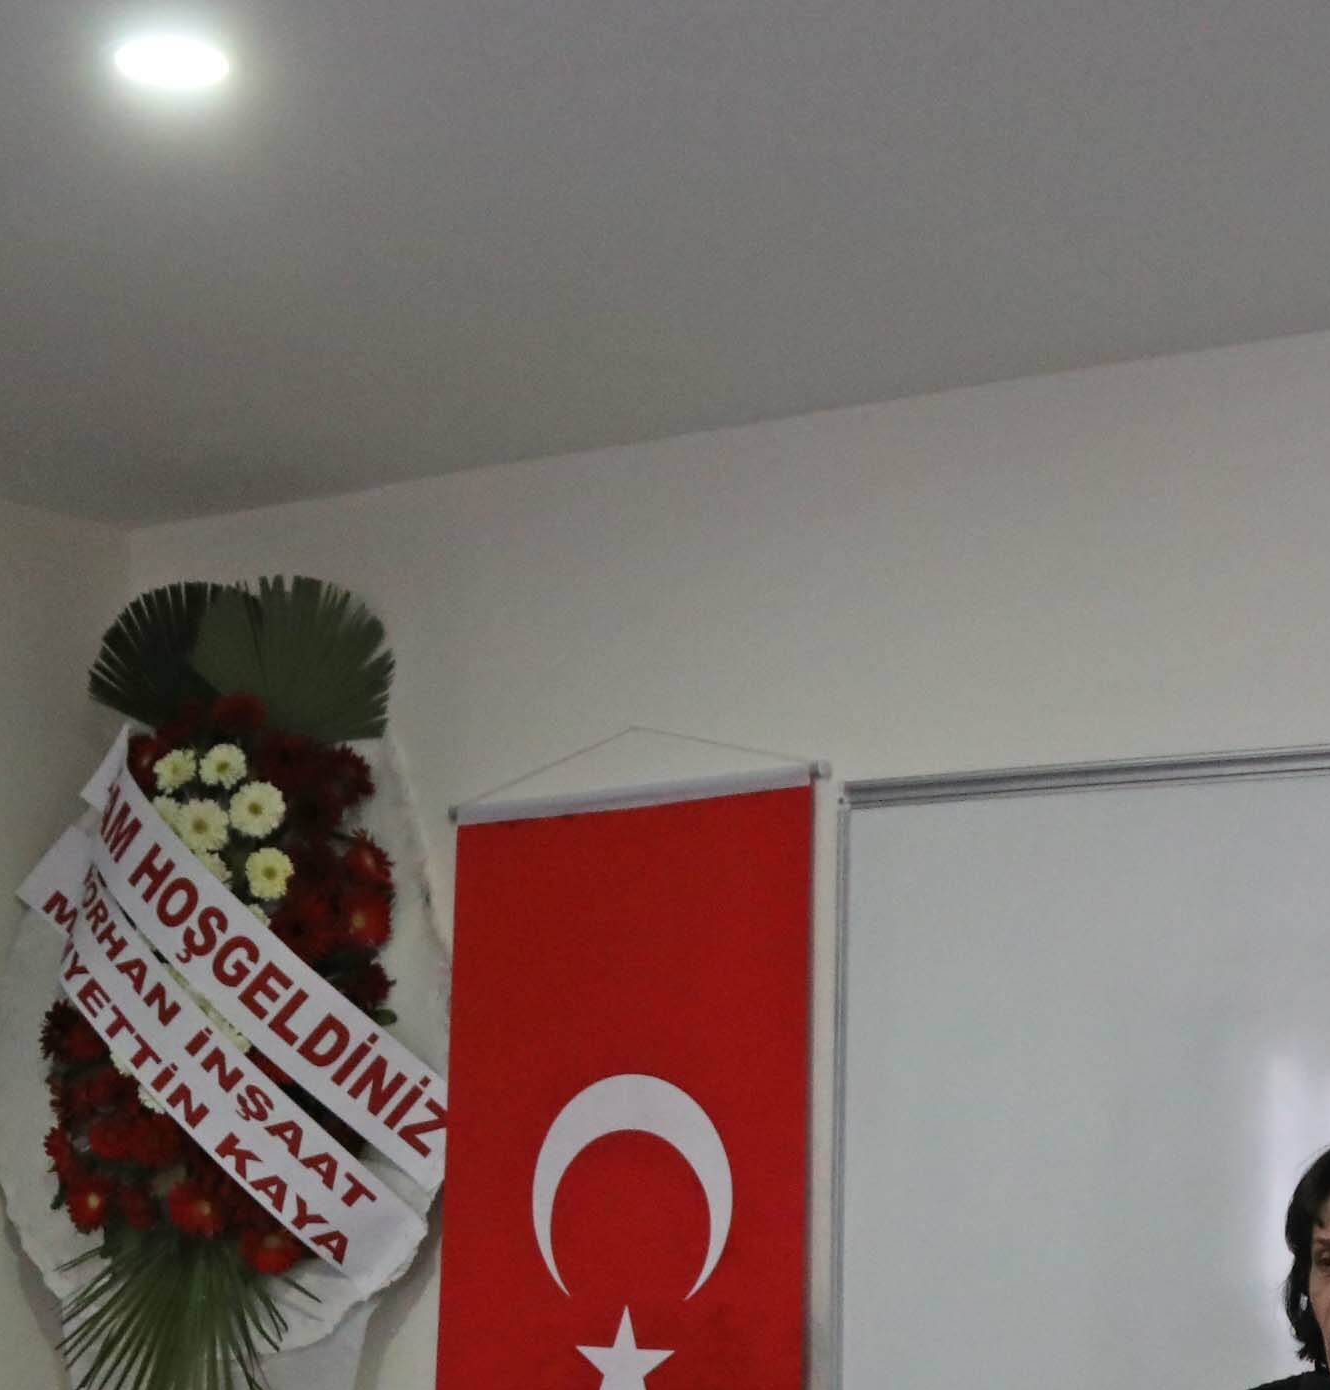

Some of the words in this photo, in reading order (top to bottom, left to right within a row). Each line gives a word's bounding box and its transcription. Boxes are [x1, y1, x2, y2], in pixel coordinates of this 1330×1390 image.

[42, 890, 210, 1130] MYETTİN
[214, 1132, 351, 1266] KAYA
[128, 843, 448, 1158] HOŞGELDİNİZ
[184, 1028, 378, 1208] İNŞAAT
